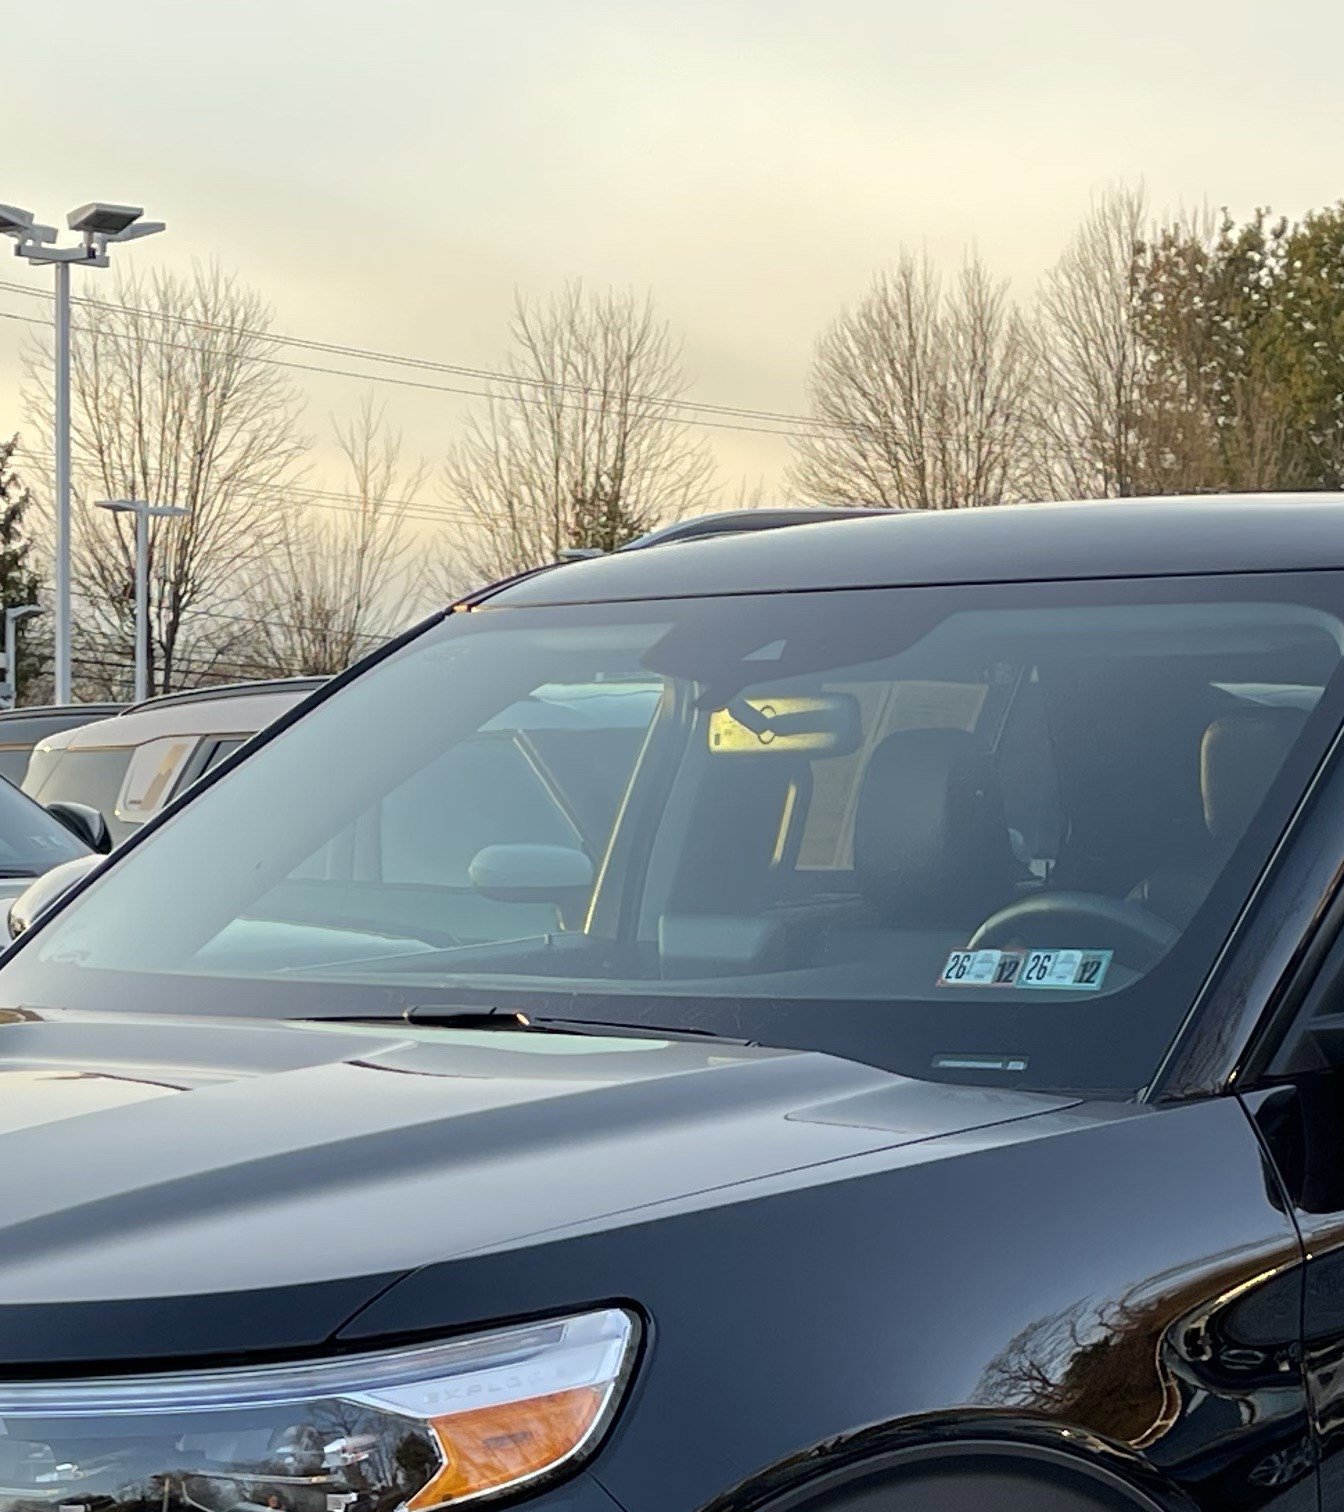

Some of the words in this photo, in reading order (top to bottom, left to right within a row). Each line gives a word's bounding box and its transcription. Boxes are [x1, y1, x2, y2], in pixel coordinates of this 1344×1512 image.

[945, 954, 970, 979] 26
[997, 961, 1020, 983] 12
[1026, 954, 1051, 980] 26
[1077, 961, 1102, 983] 12
